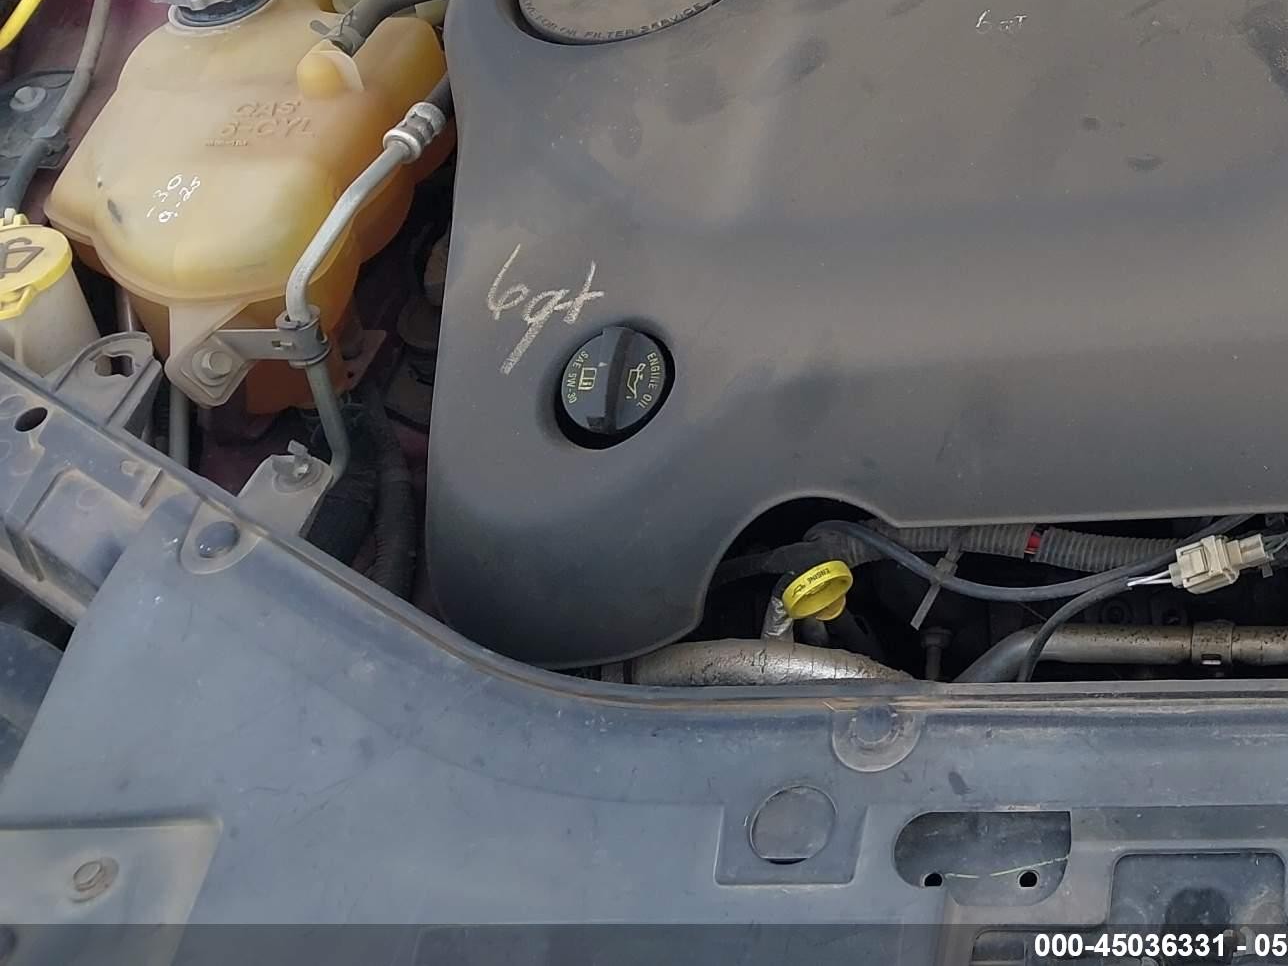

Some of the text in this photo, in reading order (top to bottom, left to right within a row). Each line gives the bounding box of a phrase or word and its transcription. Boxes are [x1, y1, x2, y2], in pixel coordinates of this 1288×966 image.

[583, 27, 636, 40] FILTER
[640, 0, 705, 34] SERVICE
[566, 350, 589, 404] SAE 5W-30
[635, 351, 662, 410] ENGINE OIL
